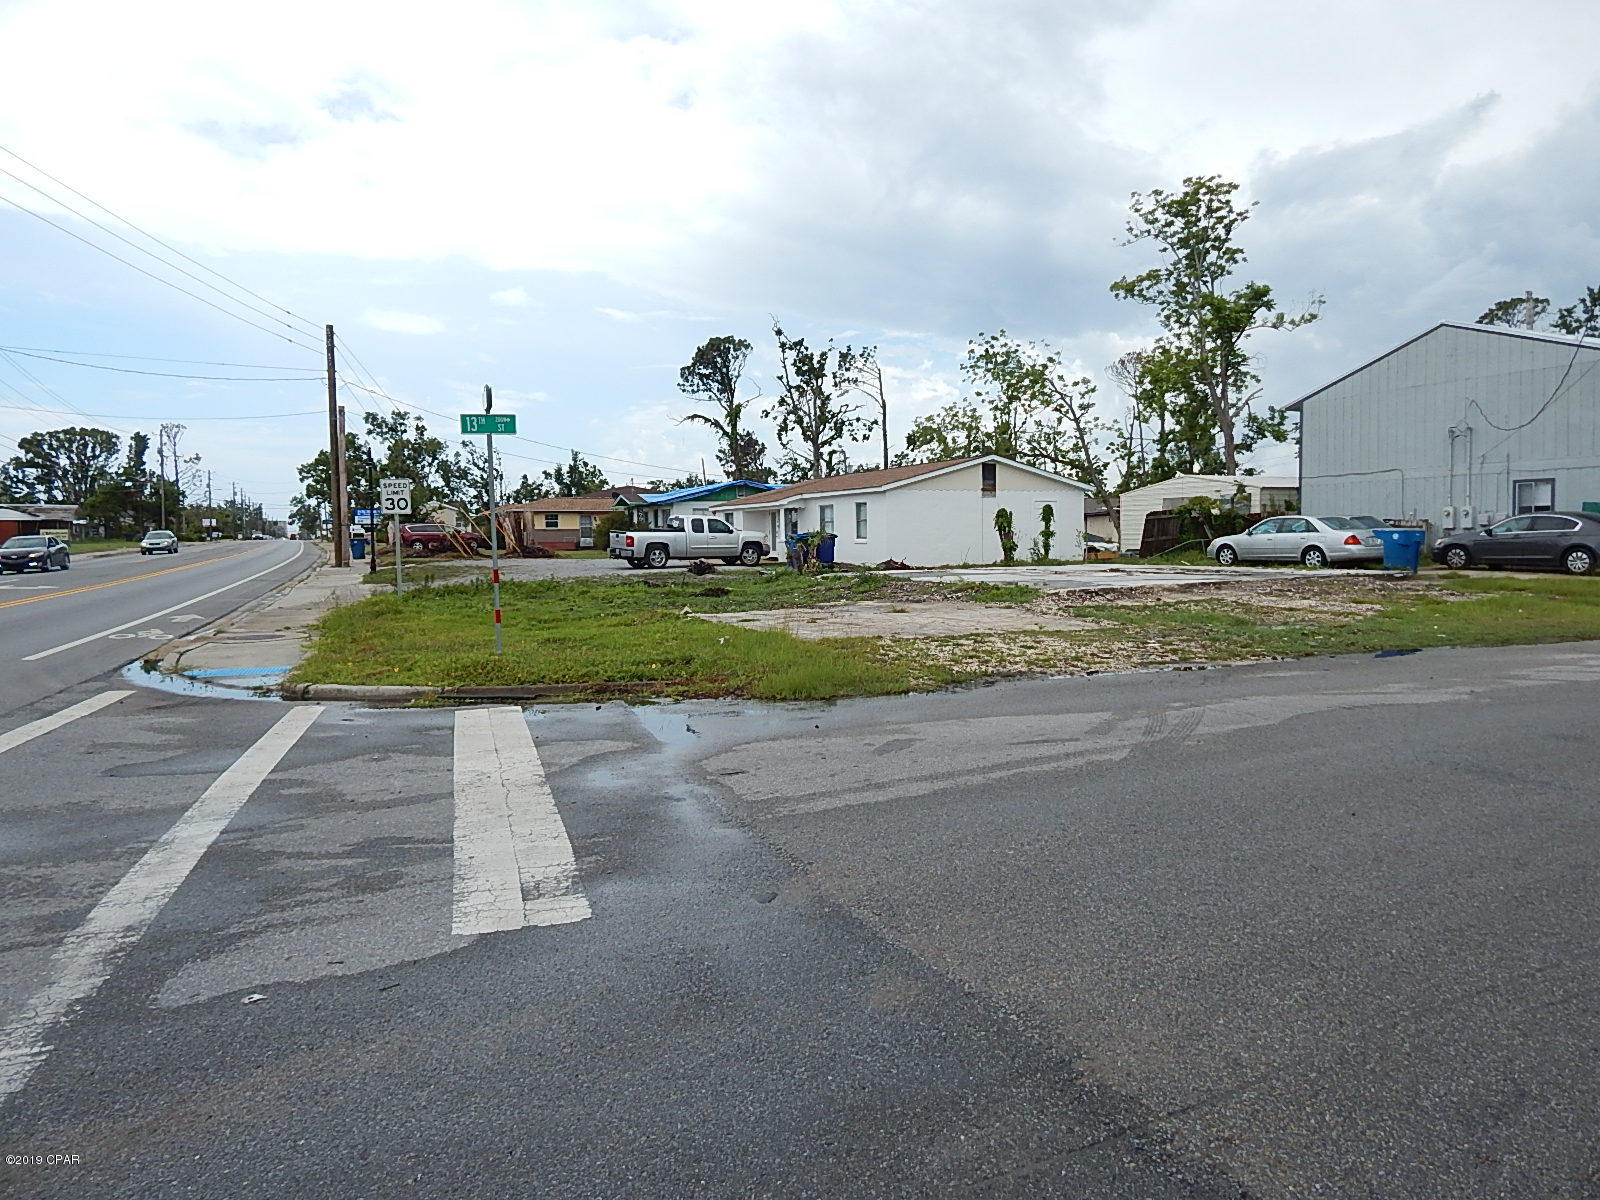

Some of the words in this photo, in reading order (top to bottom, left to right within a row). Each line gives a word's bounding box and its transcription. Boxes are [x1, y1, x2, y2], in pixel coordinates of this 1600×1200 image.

[465, 416, 486, 432] 13TH
[497, 423, 505, 432] ST
[384, 497, 409, 511] 30
